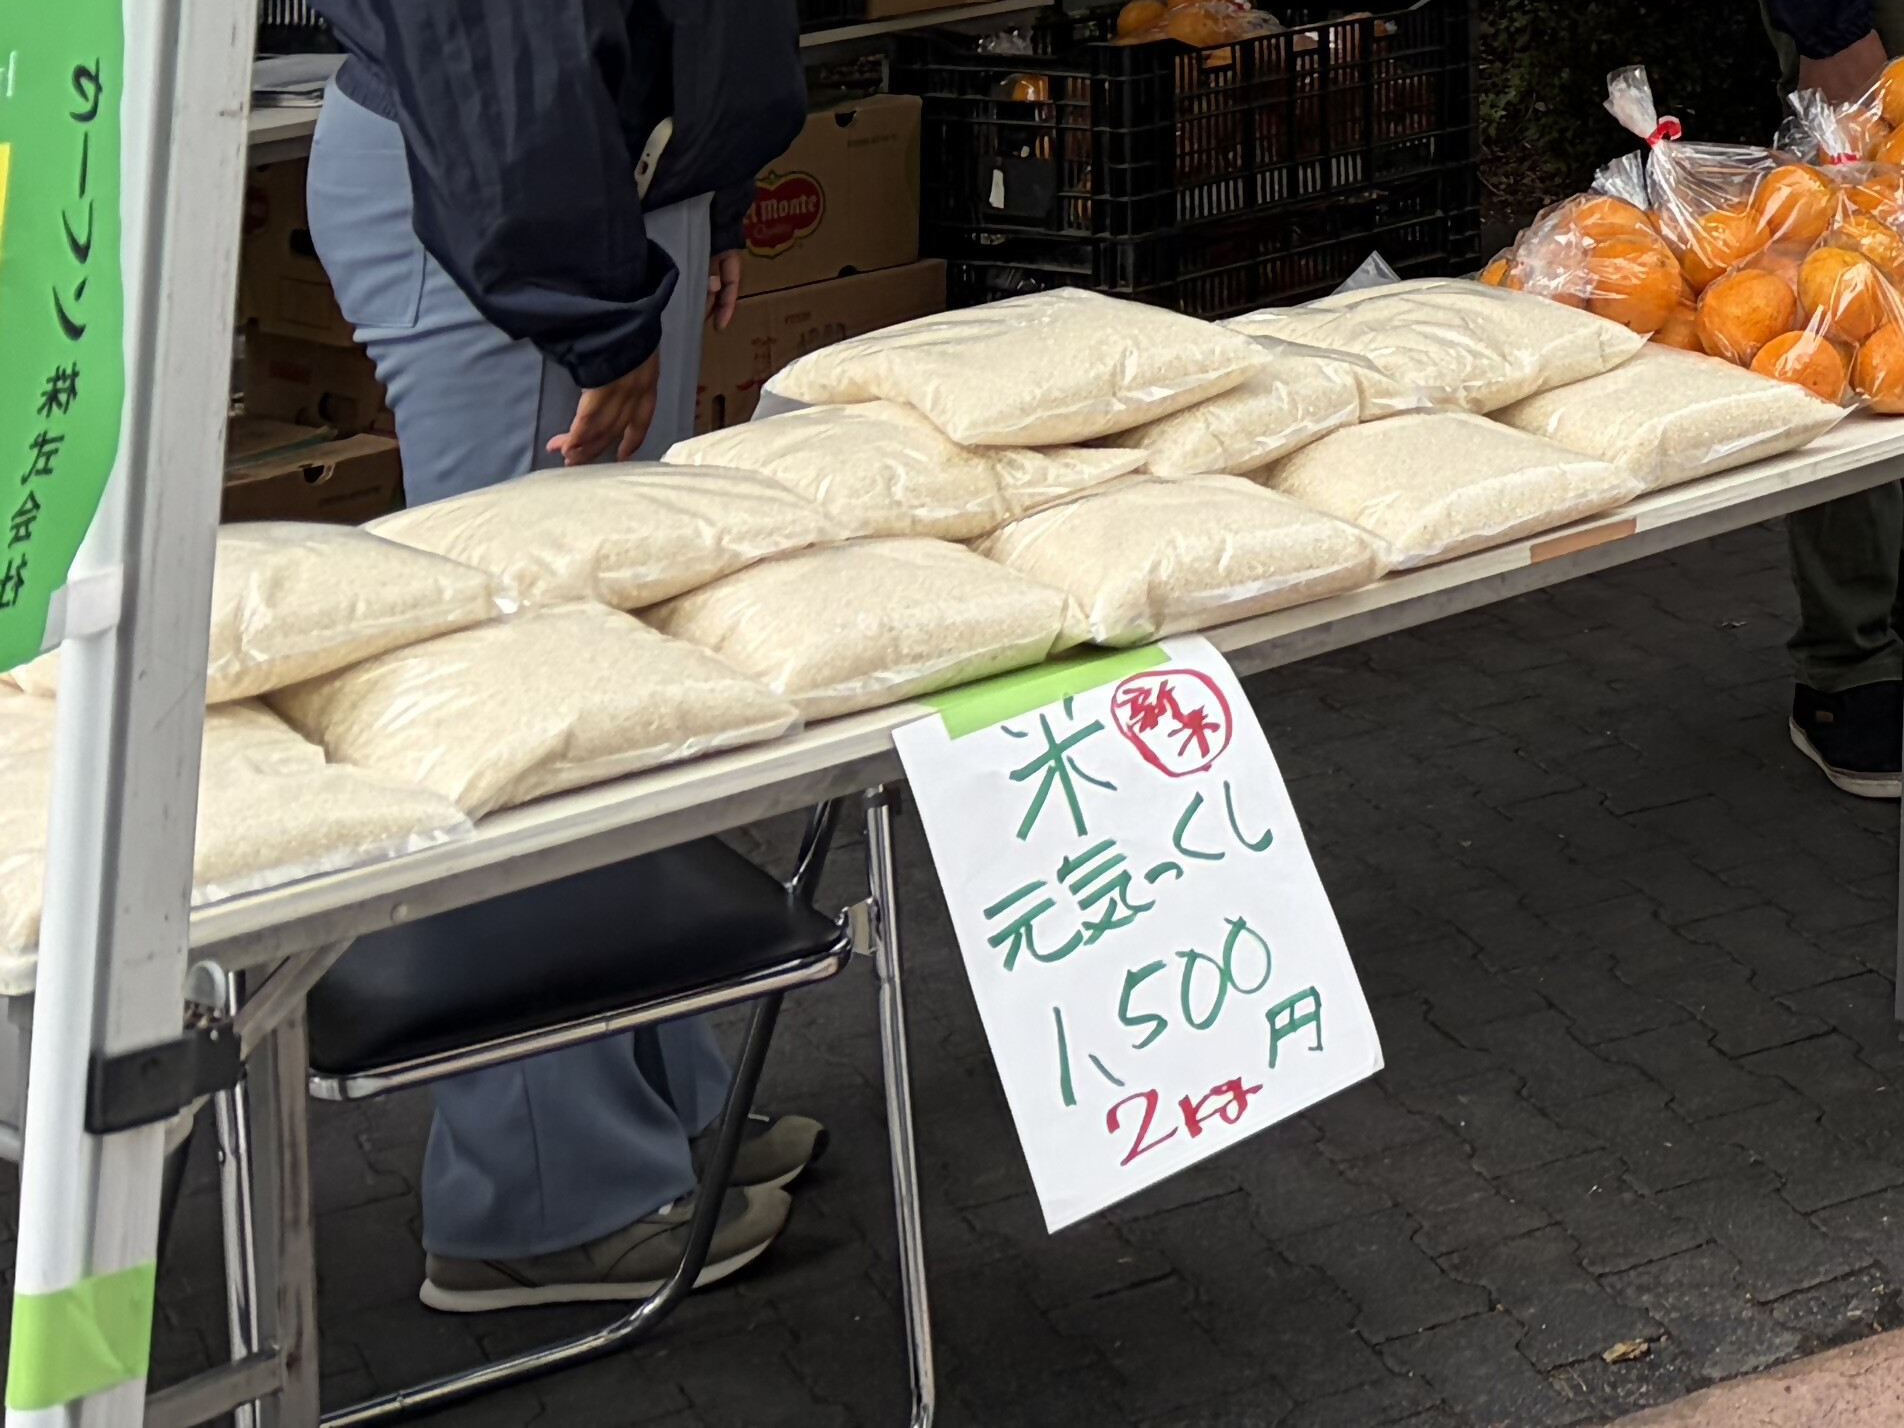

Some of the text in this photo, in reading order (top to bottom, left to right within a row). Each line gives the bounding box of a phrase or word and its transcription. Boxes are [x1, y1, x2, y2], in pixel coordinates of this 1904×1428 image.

[760, 193, 818, 222] Monte
[1001, 693, 1118, 841] 米
[1107, 1077, 1263, 1166] 2kg
